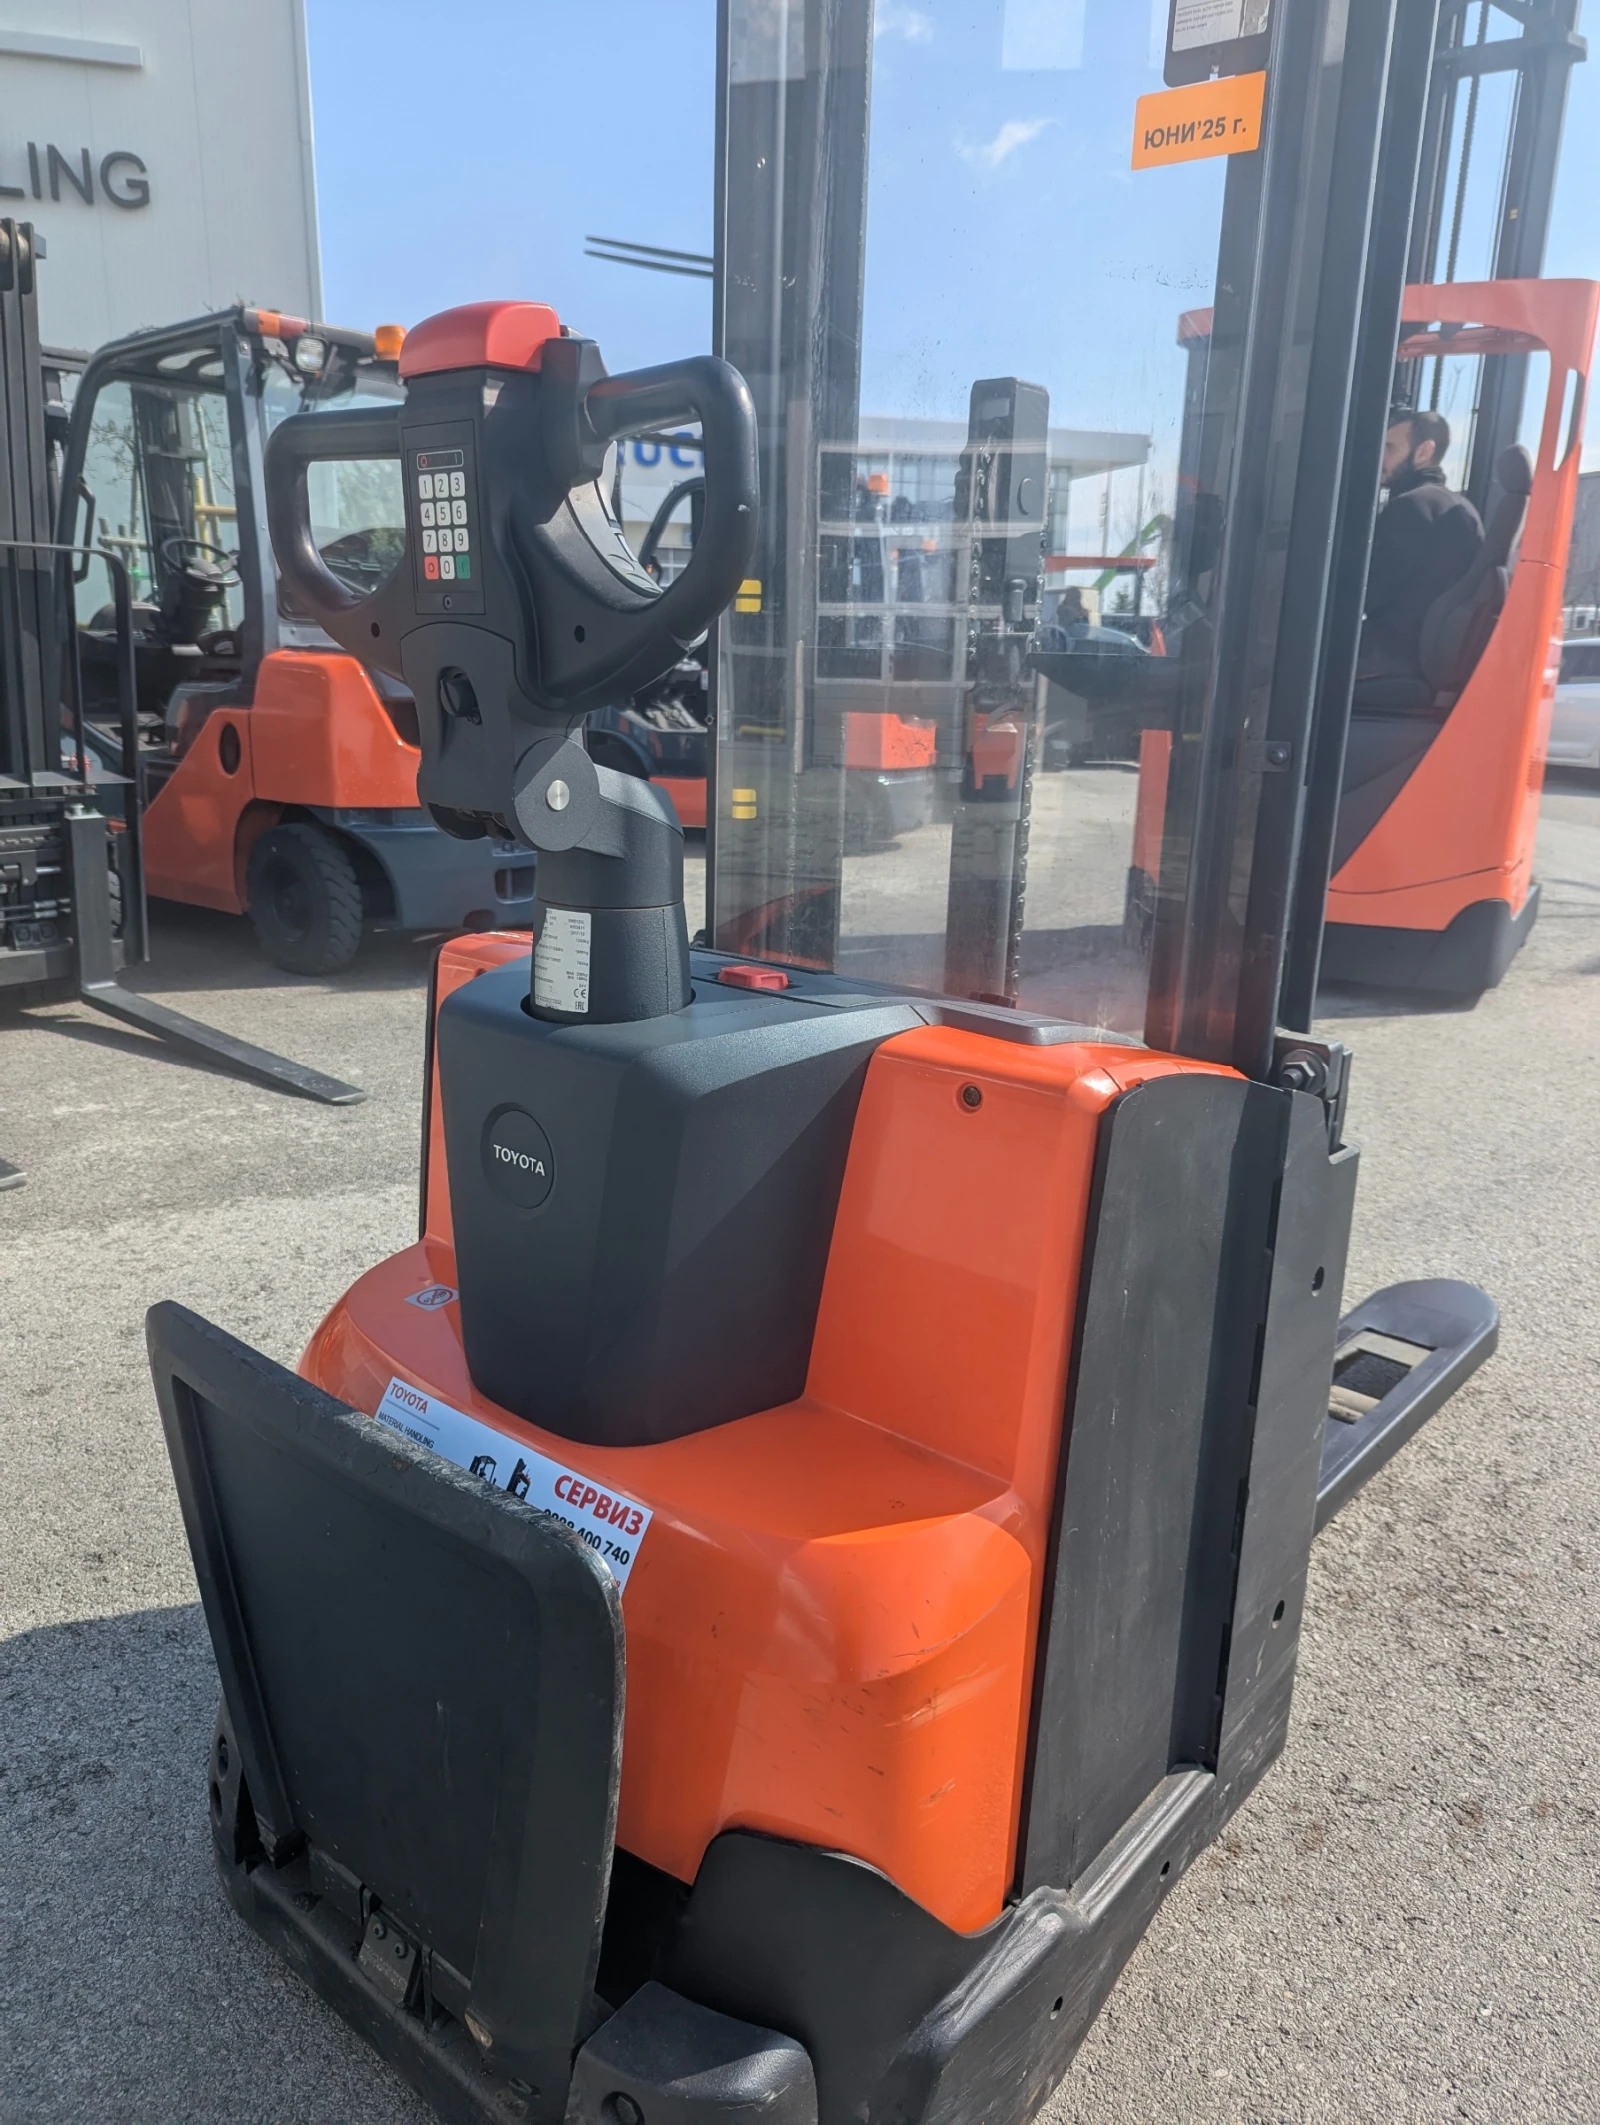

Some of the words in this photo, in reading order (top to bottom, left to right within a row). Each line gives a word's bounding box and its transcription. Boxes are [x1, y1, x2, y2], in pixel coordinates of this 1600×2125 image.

[1232, 117, 1247, 135] г.
[438, 478, 445, 493] 2
[454, 477, 461, 492] 3
[424, 507, 431, 522] 4
[440, 506, 447, 521] 5
[456, 505, 463, 520] 6
[426, 534, 432, 549] 7
[442, 533, 448, 548] 8
[458, 532, 464, 547] 9
[493, 1144, 546, 1177] TOYOTA
[390, 1383, 429, 1414] TOYOTA
[378, 1411, 404, 1431] MATERIAL
[403, 1425, 435, 1449] HANDLING
[554, 1474, 645, 1536] СЕРВИЗ
[602, 1540, 631, 1565] 740
